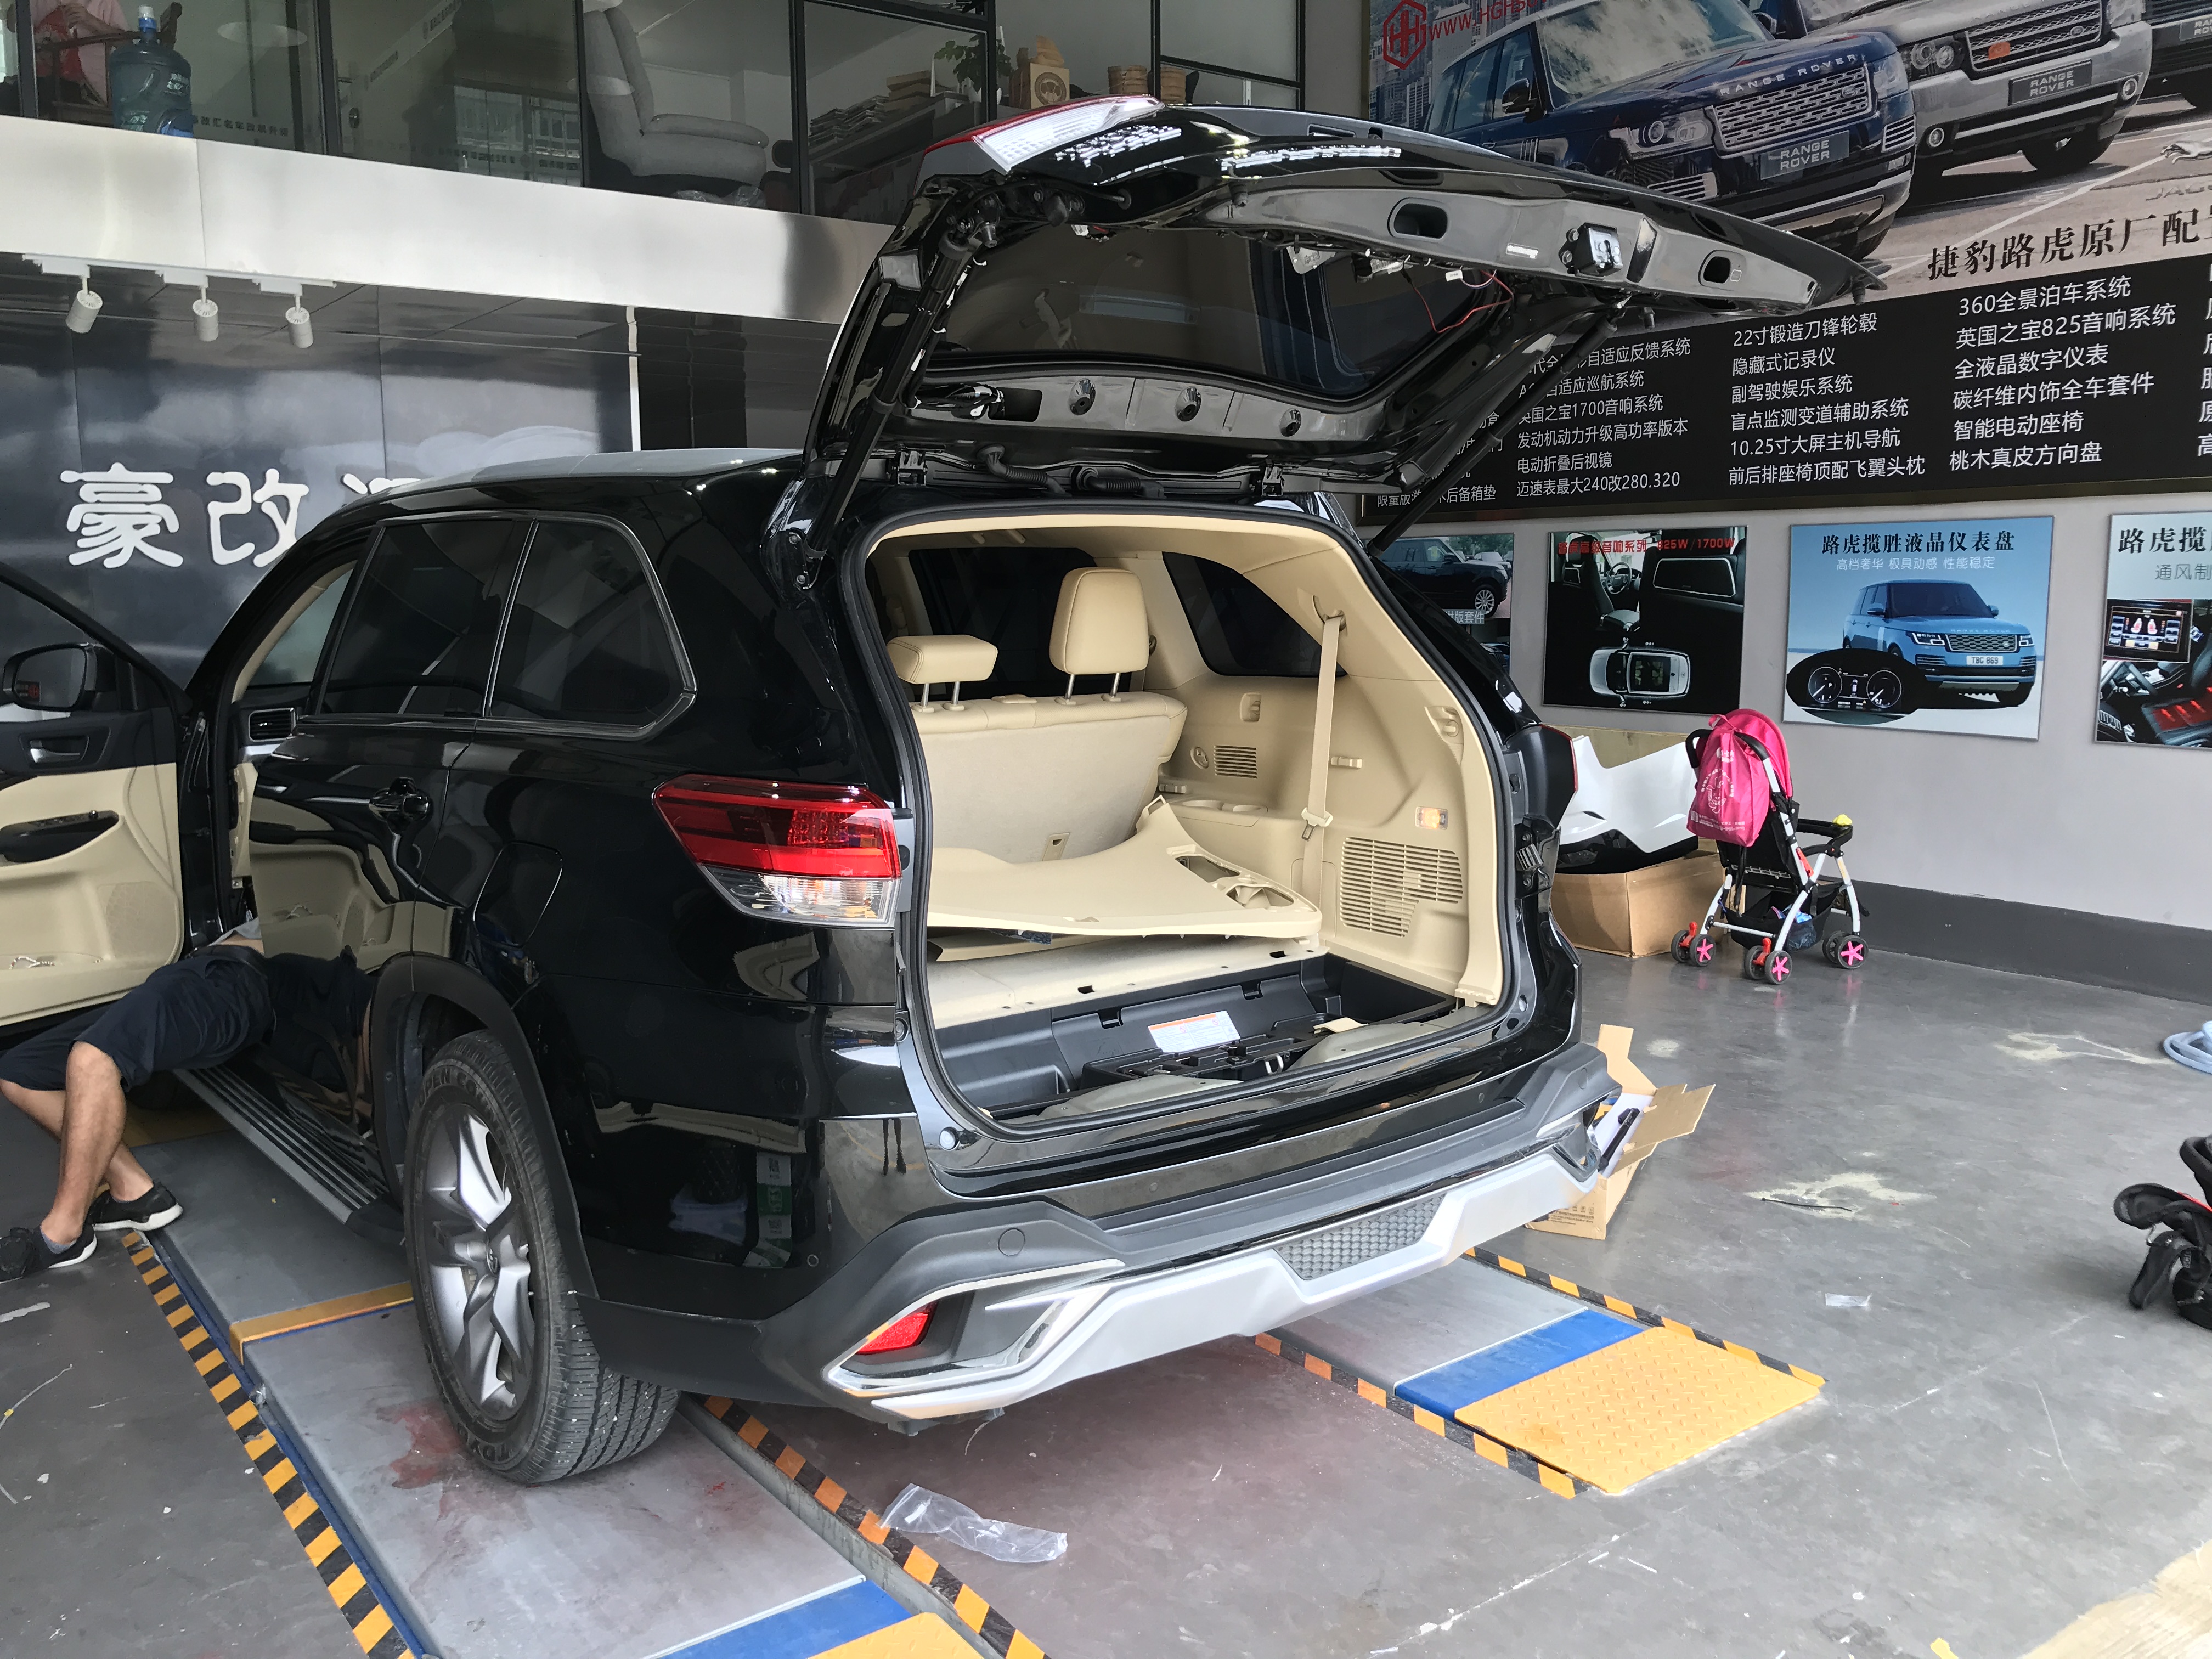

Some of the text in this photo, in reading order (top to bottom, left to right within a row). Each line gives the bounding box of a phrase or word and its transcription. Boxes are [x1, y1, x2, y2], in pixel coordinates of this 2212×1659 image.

[1719, 54, 1857, 96] RANGE ROVER
[2029, 70, 2074, 87] RANGE
[2029, 80, 2075, 97] ROVER
[1780, 139, 1830, 160] RANGE
[1780, 150, 1830, 171] ROVER
[1927, 205, 2212, 281] 捷豹路虎原厂配
[1959, 274, 2132, 316] 360全景泊车系统
[1733, 312, 1878, 347] 22寸锻造刀锋轮毂
[1956, 302, 2176, 350] 英国之宝825音响系统
[1733, 346, 1836, 377] 隐藏式记录仪
[1954, 343, 2109, 381] 全液晶数字仪表
[1731, 373, 1853, 404] 副驾驶娱乐系统
[1953, 371, 2155, 410] 碳纤维内饰全车套件
[1730, 397, 1909, 432] 盲点监测变道辅助系统
[1953, 410, 2085, 441] 智能电动座椅
[1517, 417, 1689, 449] 发动机动力升级高功率版本
[1730, 427, 1901, 456] 10.25寸大屏主机导航
[1517, 450, 1613, 474] 电动折叠后视镜
[1729, 455, 1926, 486] 前后排座椅顶配飞翼头枕
[1949, 441, 2103, 471] 桃木真皮方向盘
[1516, 471, 1680, 498] 迈速表最大240改280.320
[60, 462, 421, 568] 豪改
[1558, 540, 1646, 555] 路虎高级音响系列
[1821, 529, 2015, 555] 路虎揽胜液晶仪表盘
[2118, 526, 2212, 554] 路虎揽
[1836, 556, 1995, 571] 高档奢华 极具动感 性能稳定
